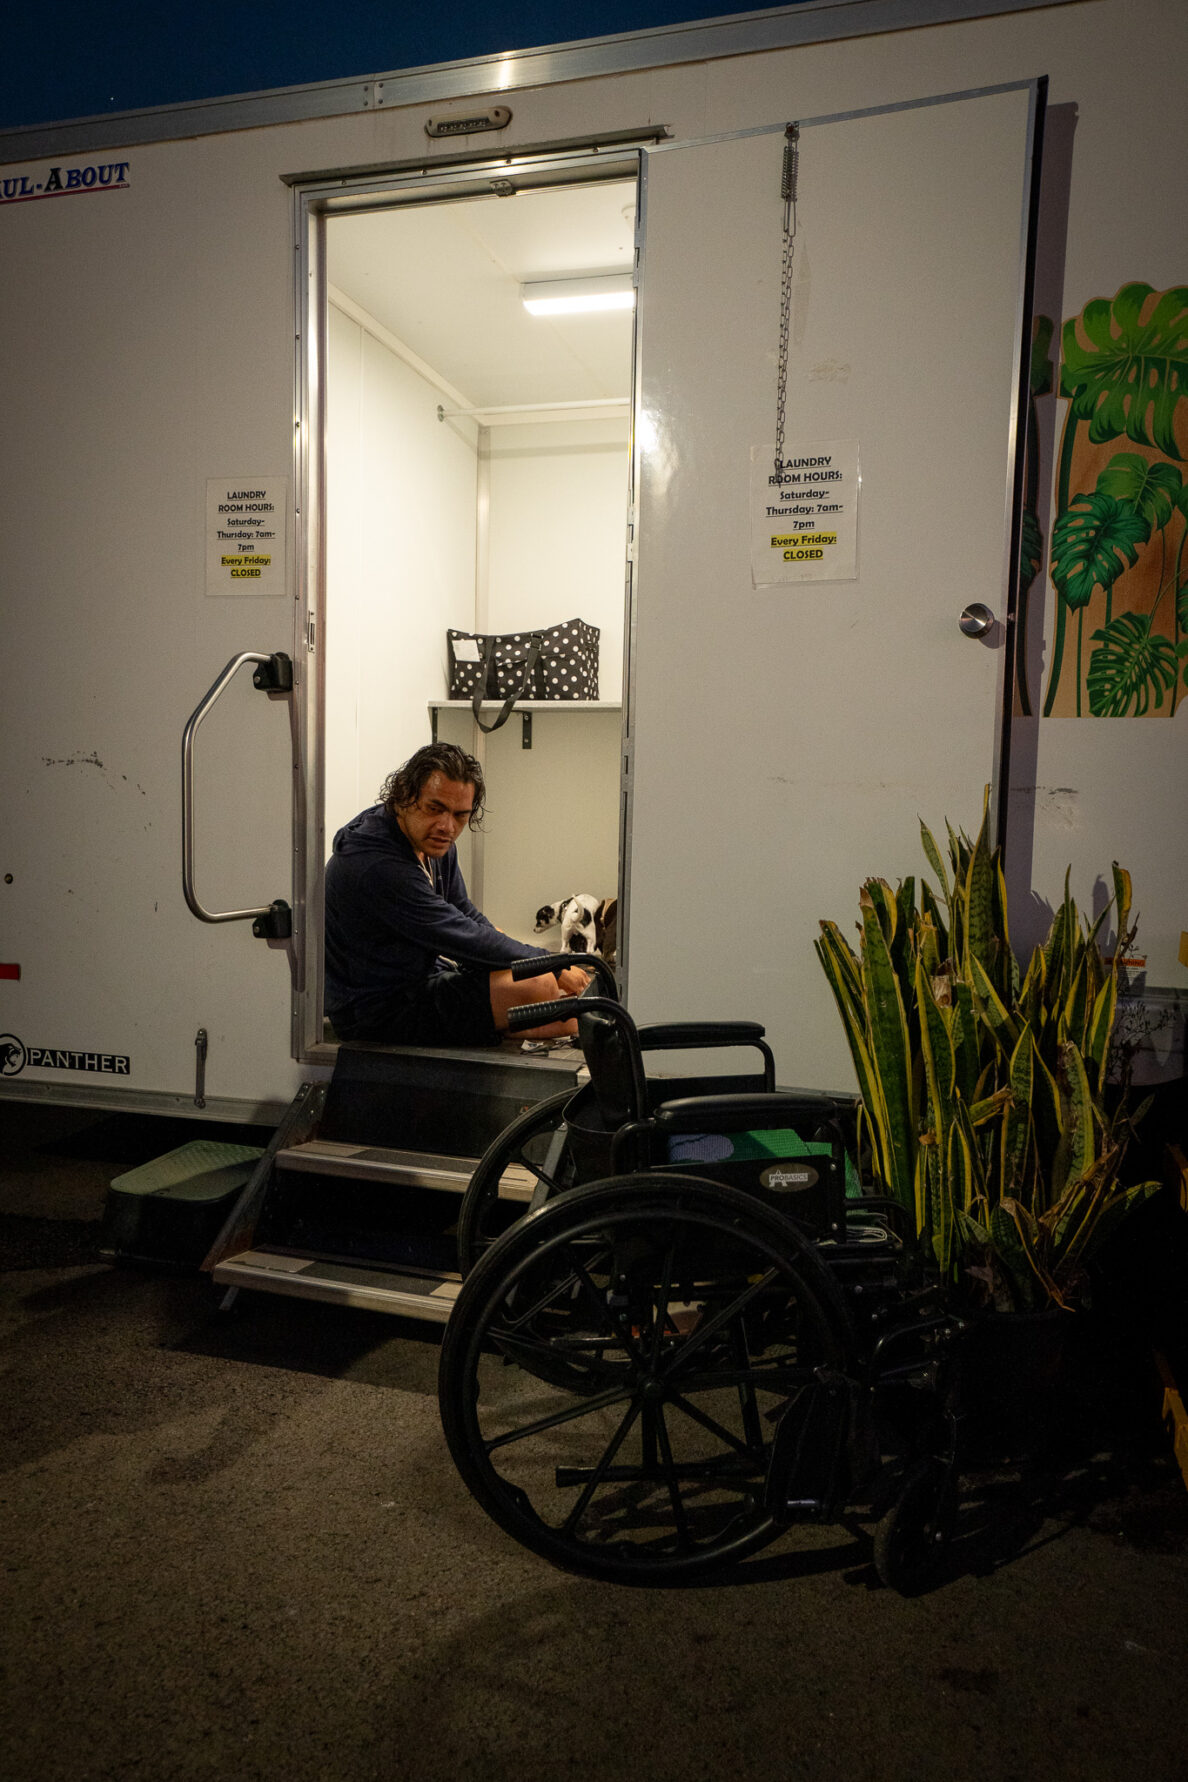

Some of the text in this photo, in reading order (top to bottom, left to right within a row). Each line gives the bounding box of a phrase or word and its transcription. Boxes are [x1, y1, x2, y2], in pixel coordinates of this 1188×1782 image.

[780, 456, 832, 469] LAUNDRY
[768, 470, 843, 485] ROOM HOURS:
[227, 491, 266, 500] LAUNDRY
[780, 489, 830, 500] Saturday-
[218, 503, 275, 513] ROOM HOURS:
[766, 503, 843, 516] Thursday: 7am-
[227, 518, 265, 526] Saturday-
[793, 521, 815, 530] 7pm
[217, 530, 276, 539] Thursday: 7am-
[771, 534, 837, 547] Every Friday:
[238, 544, 255, 552] 7pm
[783, 549, 824, 560] CLOSED
[221, 556, 271, 566] Every Friday:
[231, 568, 261, 578] CLOSED
[29, 1048, 128, 1073] PANTHER
